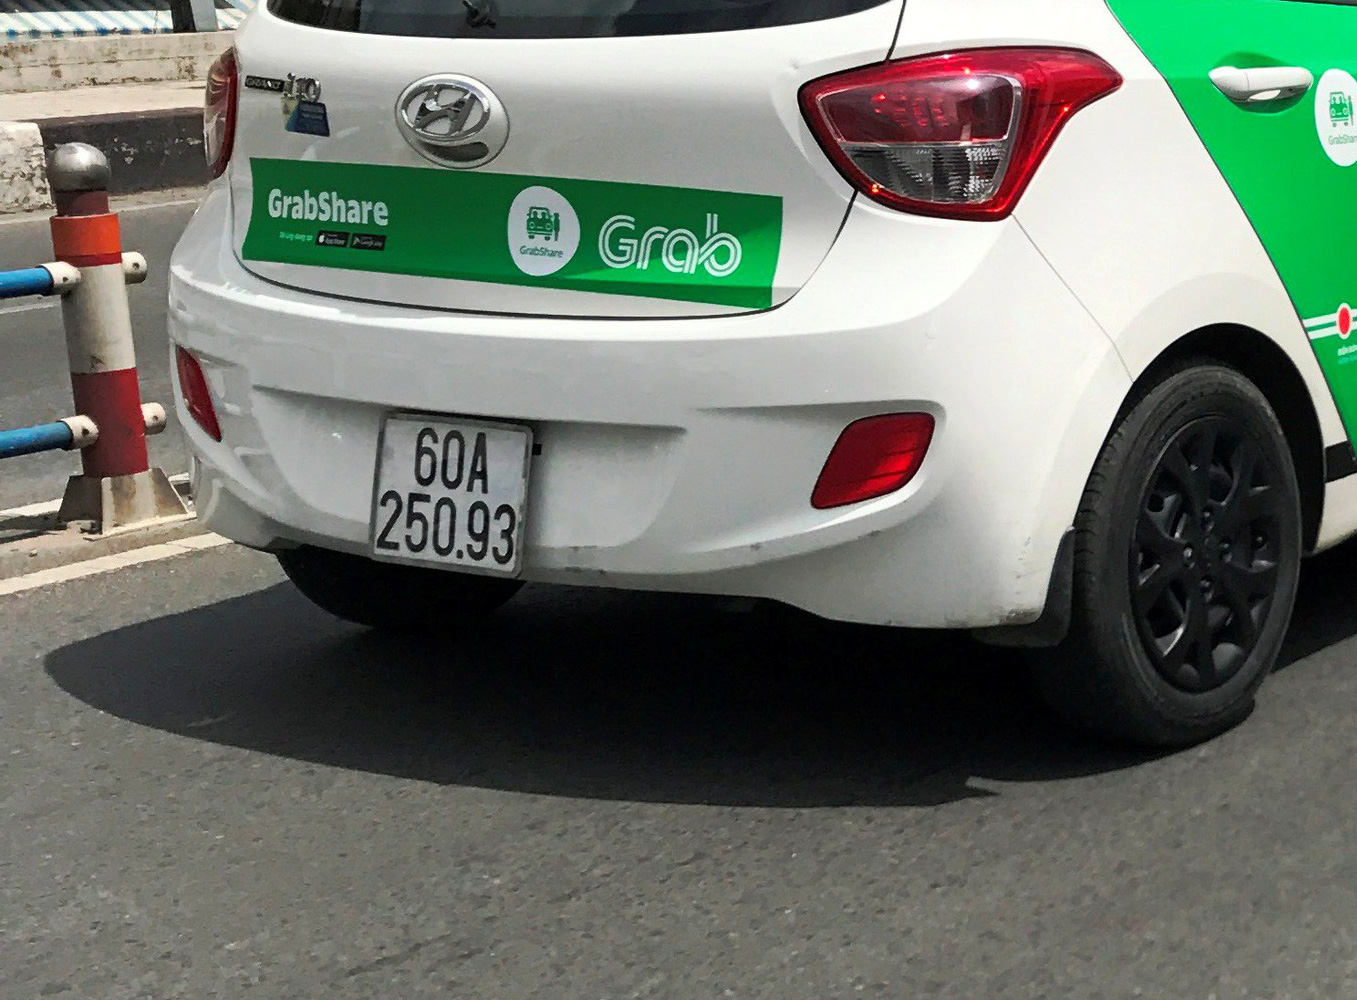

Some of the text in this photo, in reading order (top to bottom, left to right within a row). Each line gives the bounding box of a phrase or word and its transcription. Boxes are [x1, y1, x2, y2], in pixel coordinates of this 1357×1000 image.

[268, 188, 389, 226] GrabShare
[519, 245, 564, 259] GrabShare
[598, 213, 742, 277] Grab
[414, 427, 488, 494] 60A
[376, 490, 516, 564] 250.93
